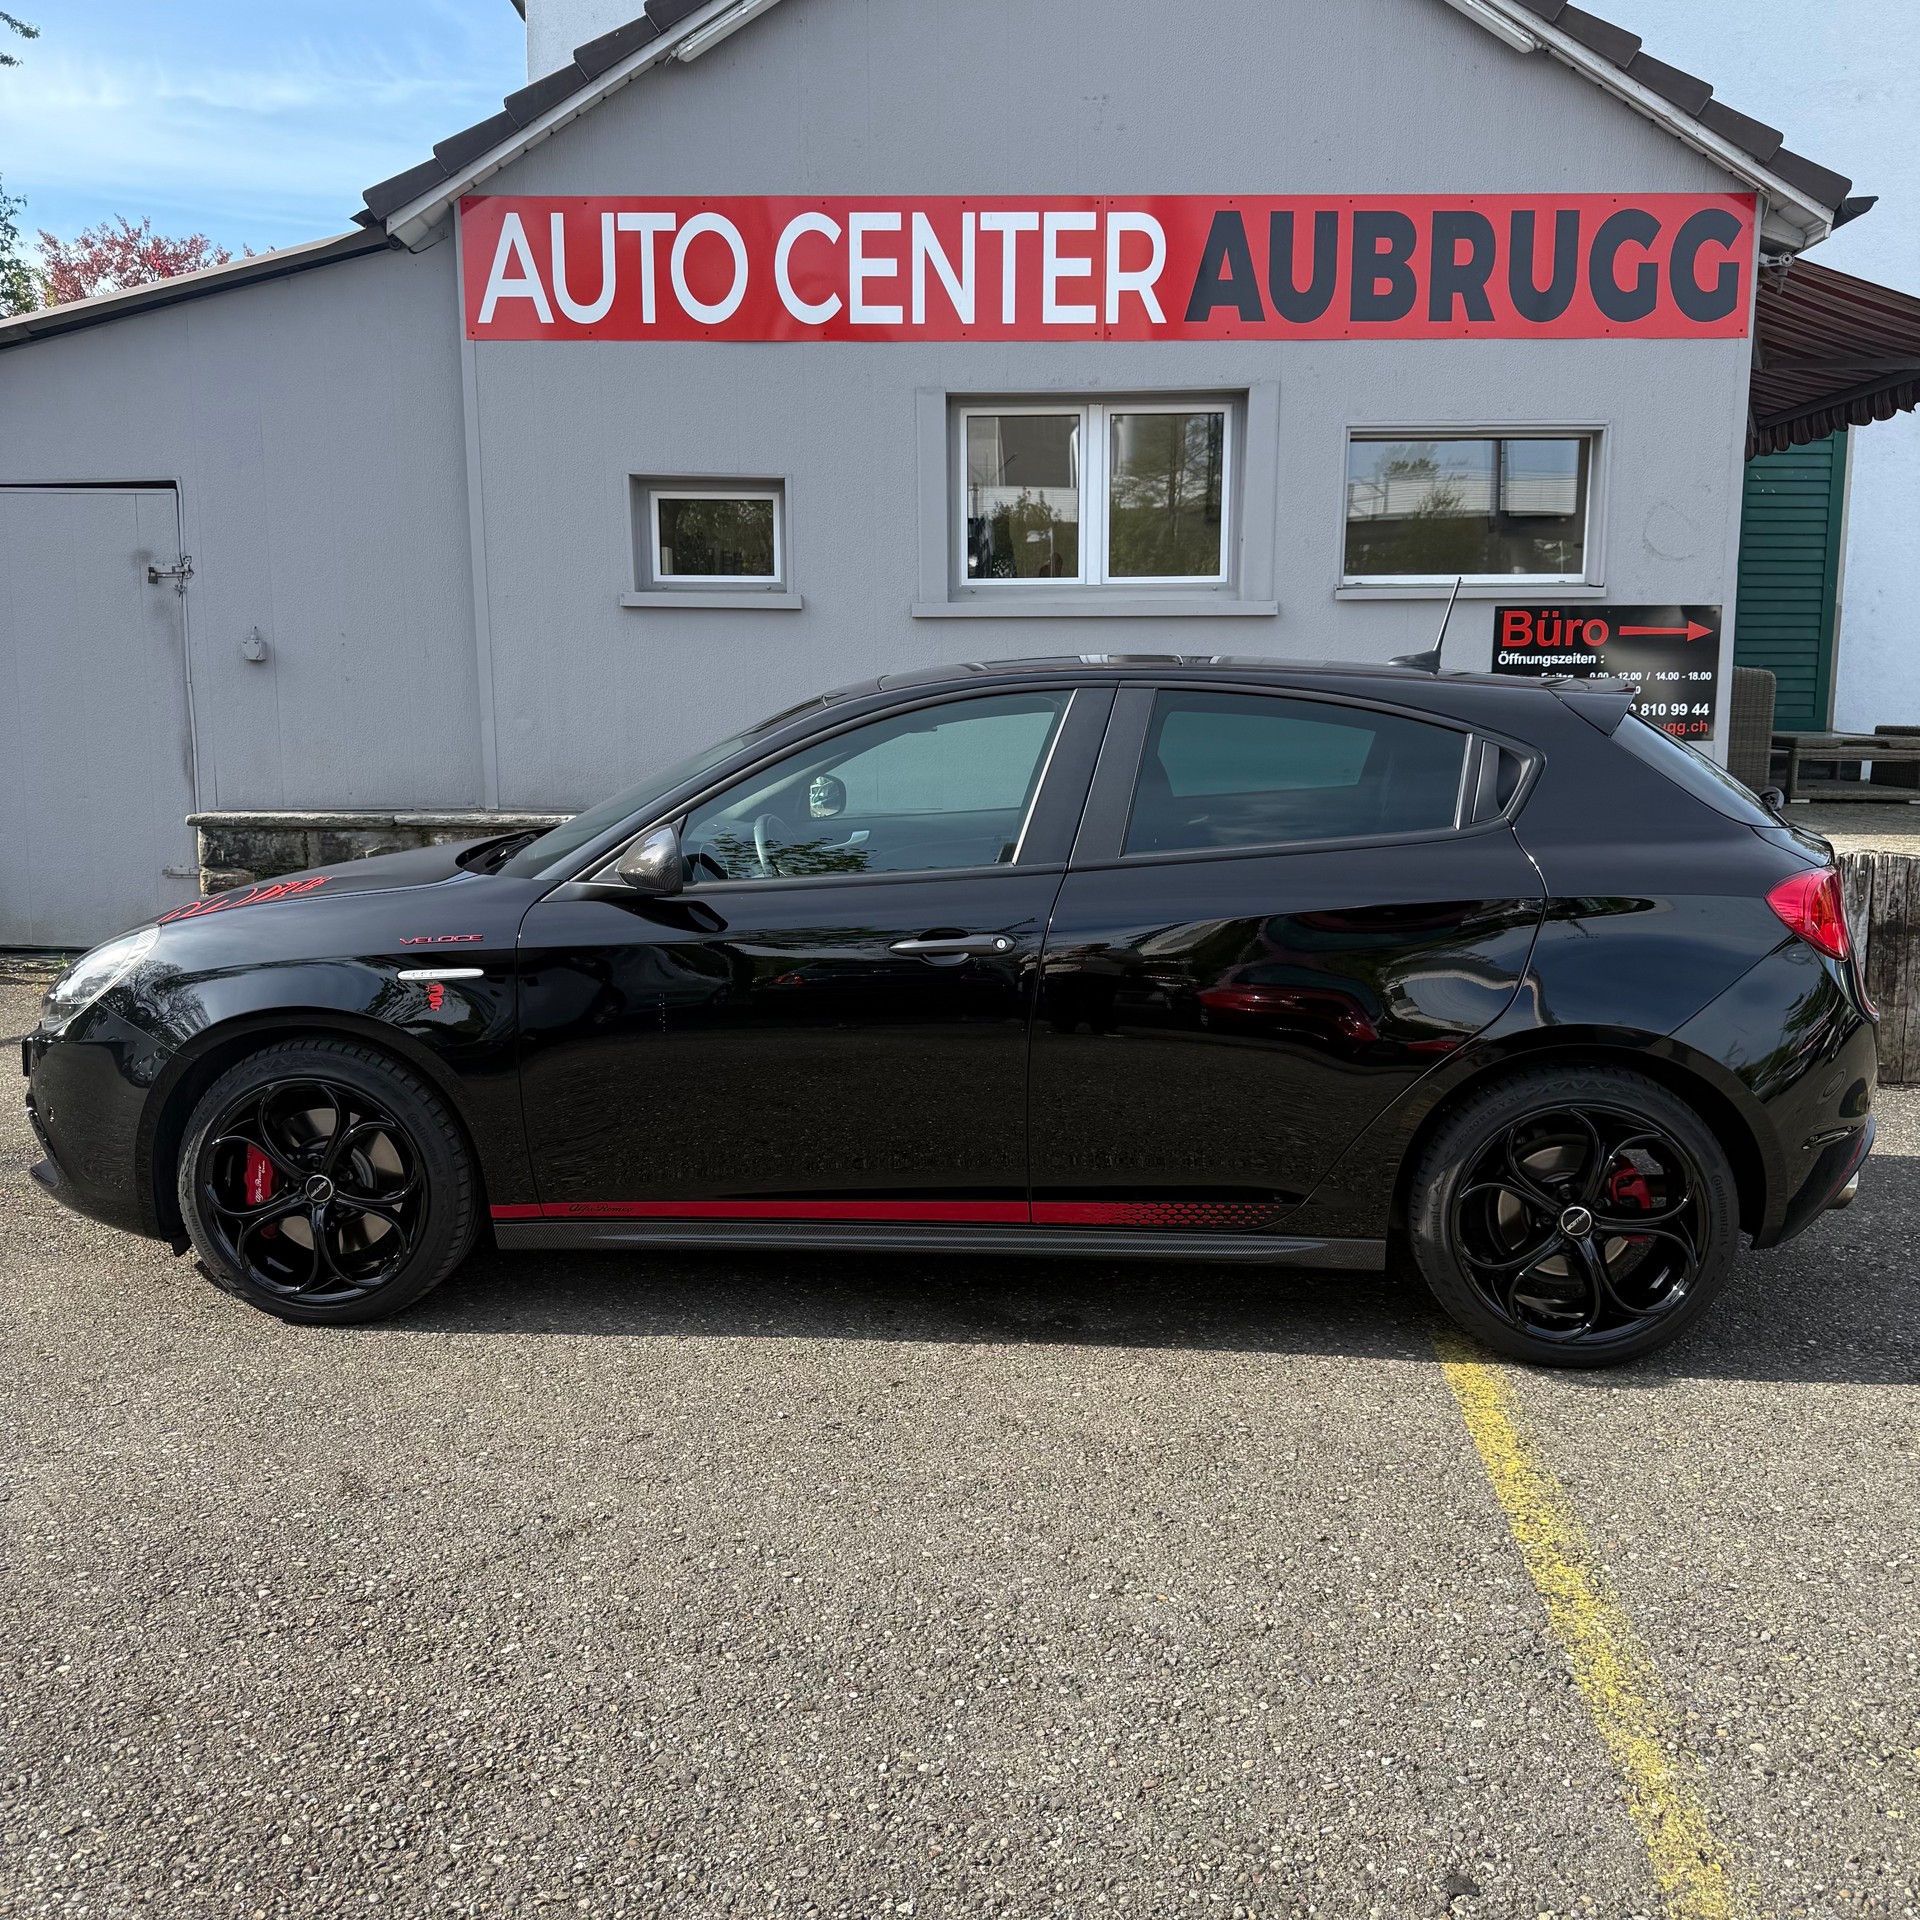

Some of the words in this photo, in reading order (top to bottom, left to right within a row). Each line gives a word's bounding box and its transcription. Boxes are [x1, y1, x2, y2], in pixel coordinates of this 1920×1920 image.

[478, 212, 748, 324] AUTO
[774, 211, 1167, 324] CENTER
[1184, 208, 1743, 322] AUBRUGG
[1502, 611, 1609, 647] Büro
[1498, 651, 1597, 667] Öffnungszeiten
[1617, 672, 1642, 681] 12.00
[1655, 671, 1680, 681] 14.00
[1688, 671, 1712, 681] 18.00
[1640, 703, 1666, 716] 810
[1670, 703, 1688, 716] 99
[1691, 703, 1710, 716] 44
[399, 935, 484, 945] VELOCE
